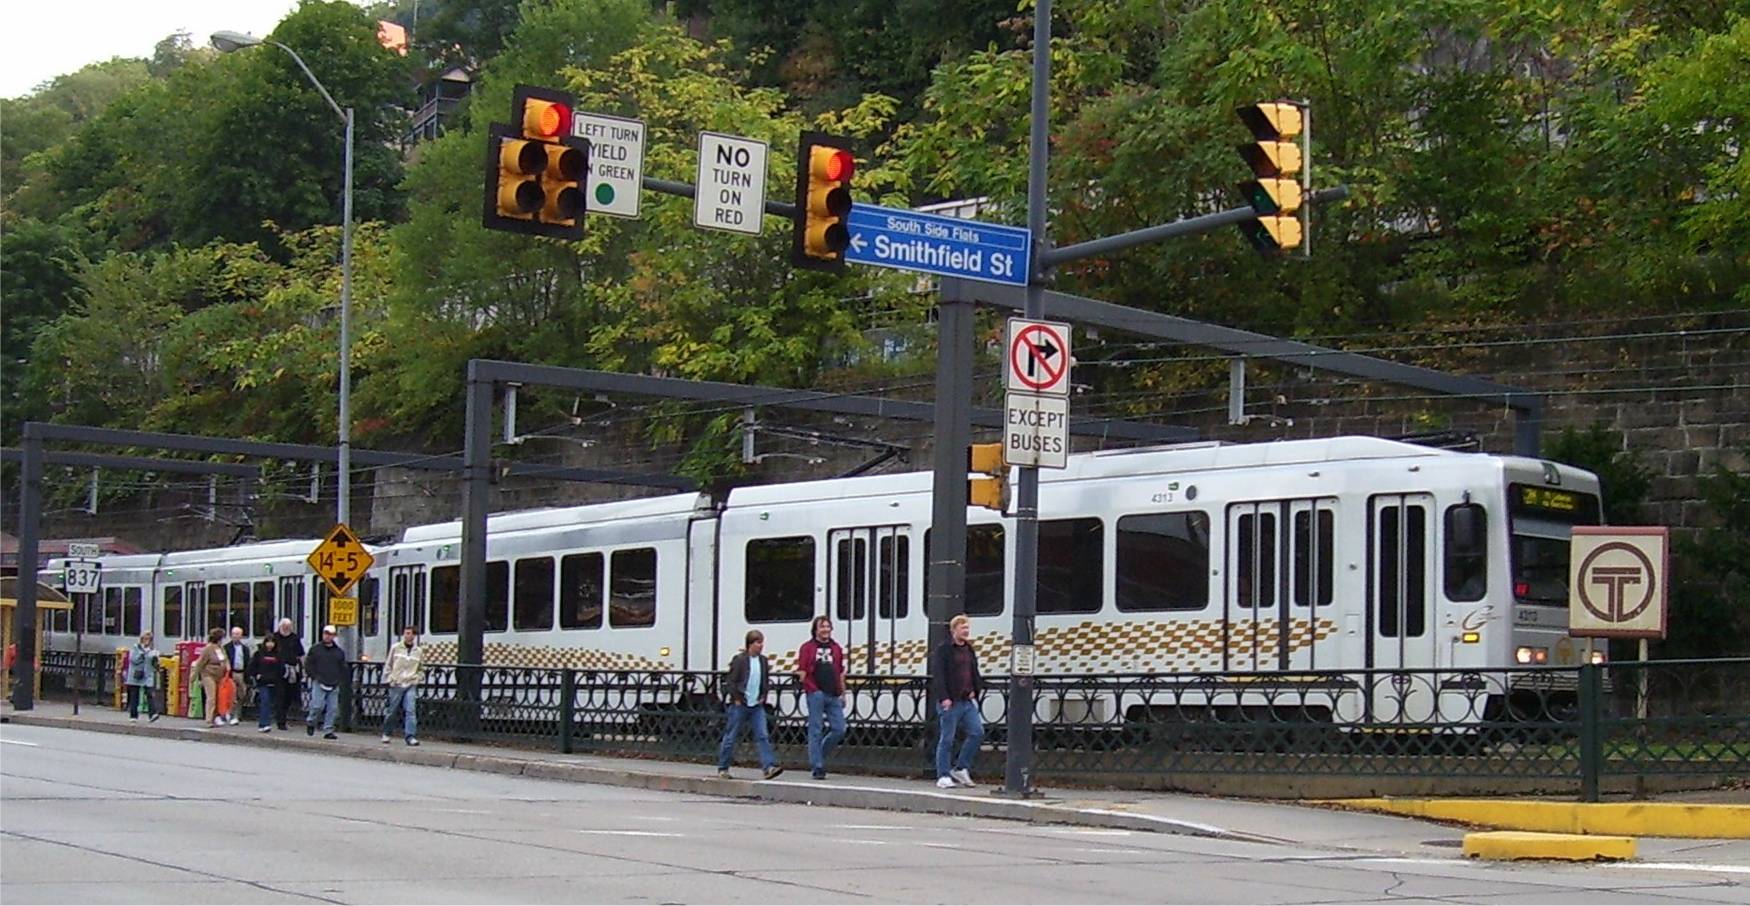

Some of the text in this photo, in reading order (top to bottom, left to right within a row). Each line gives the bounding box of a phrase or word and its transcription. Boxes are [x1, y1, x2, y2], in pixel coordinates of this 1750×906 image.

[578, 122, 639, 142] LEFT TURN
[588, 143, 627, 161] YIELD
[716, 143, 750, 168] NO
[598, 164, 635, 181] GREEN
[713, 168, 751, 188] TURN
[719, 189, 742, 206] ON
[715, 207, 743, 225] RED
[887, 217, 979, 243] South Side Flats
[874, 234, 1013, 277] Smithfield St
[1008, 408, 1065, 429] EXCEPT
[1010, 433, 1062, 453] BUSES
[1151, 492, 1173, 503] 4313
[70, 544, 98, 555] SOUTH
[67, 568, 99, 587] 837
[333, 612, 353, 622] FEET
